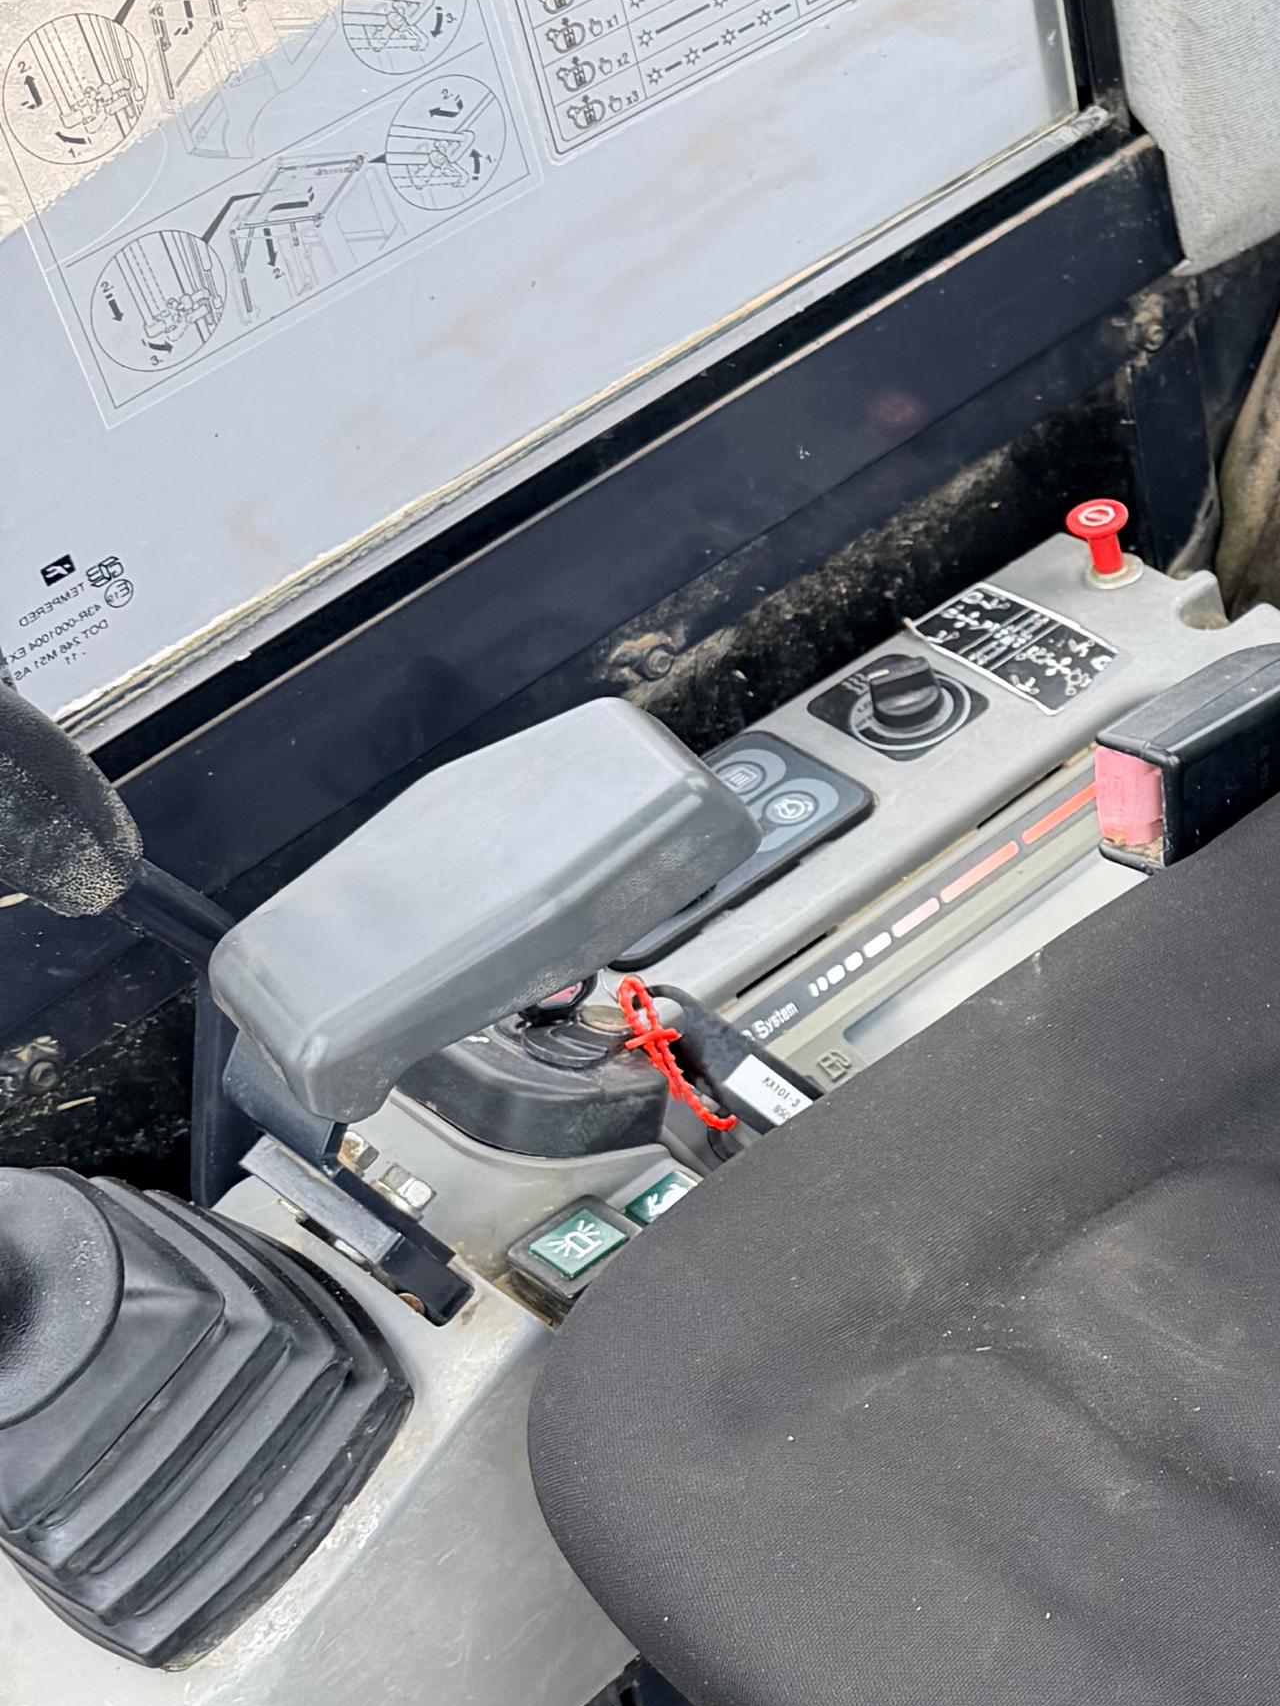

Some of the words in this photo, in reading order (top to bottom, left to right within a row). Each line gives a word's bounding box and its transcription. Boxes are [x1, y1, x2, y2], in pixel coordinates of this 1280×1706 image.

[616, 52, 630, 68] x2
[626, 90, 640, 106] x3
[754, 1002, 799, 1039] System
